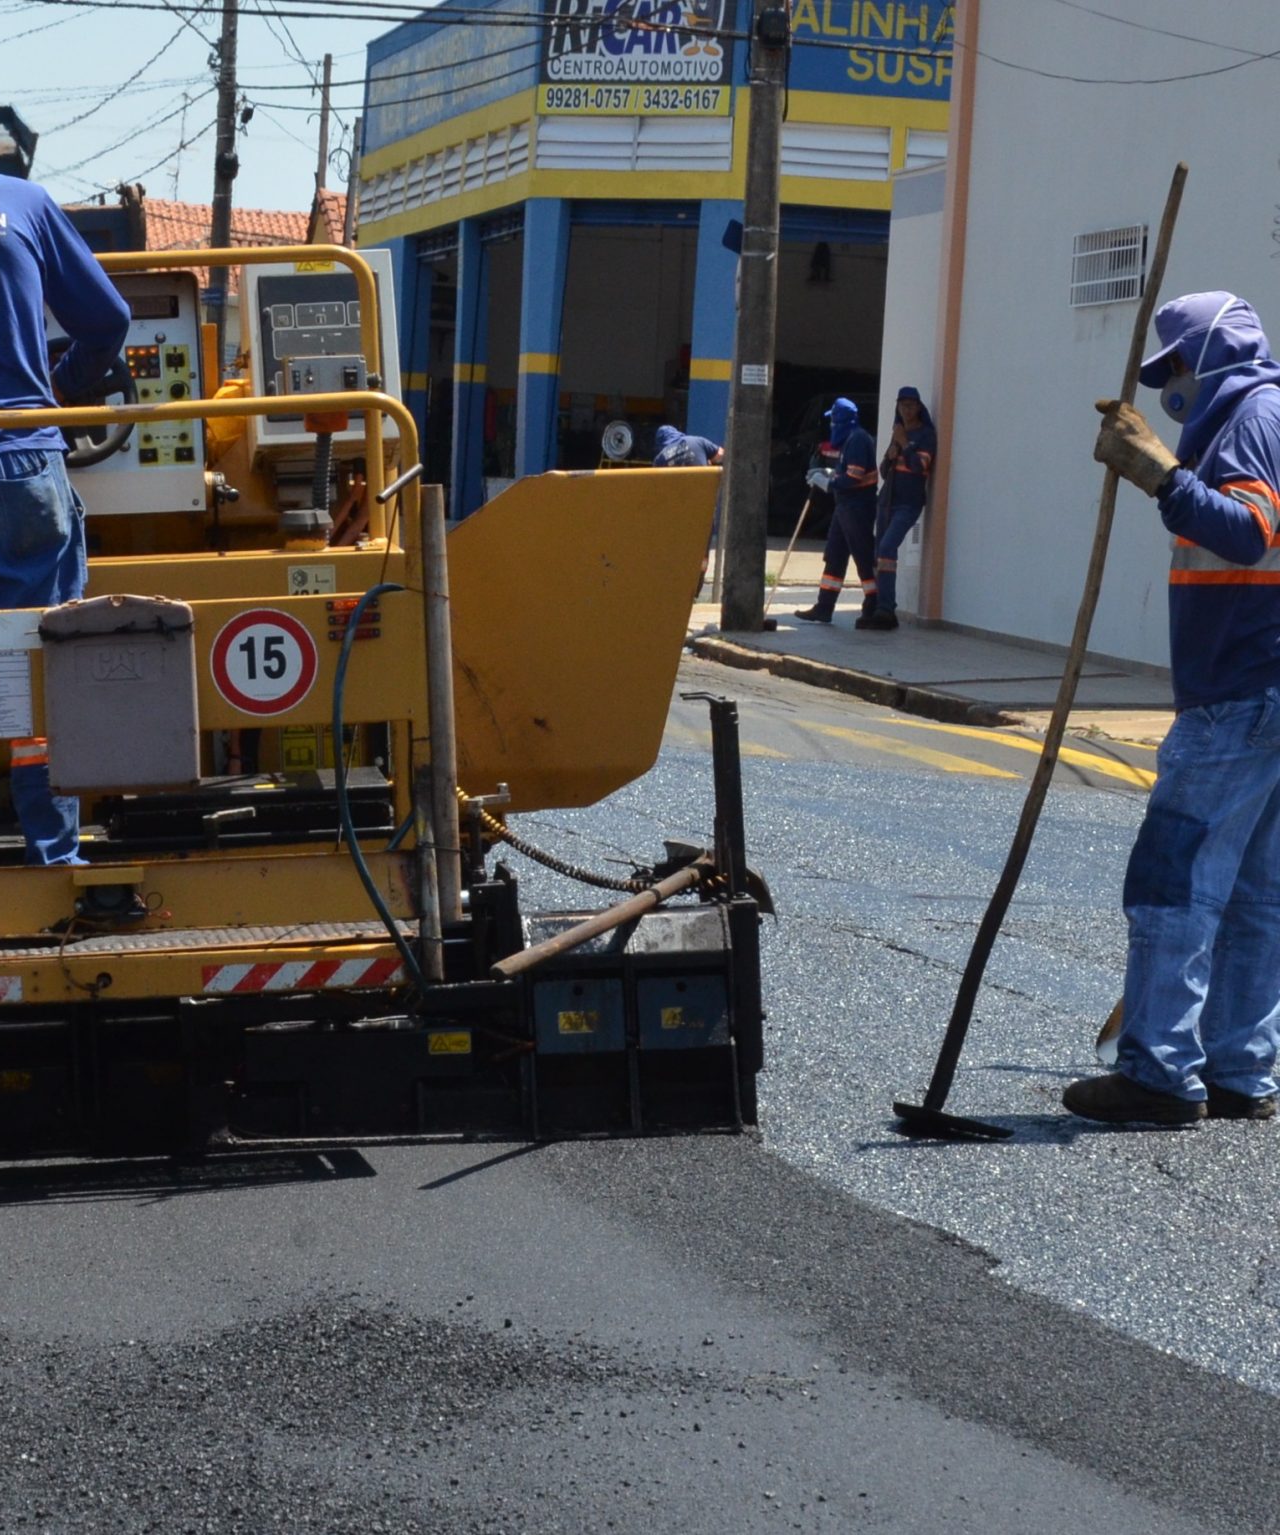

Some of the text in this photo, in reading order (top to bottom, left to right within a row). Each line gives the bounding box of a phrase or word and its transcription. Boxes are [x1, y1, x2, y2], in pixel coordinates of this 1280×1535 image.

[546, 87, 630, 109] 99281-0757
[643, 89, 720, 110] 3432-6167
[239, 635, 287, 680] 15
